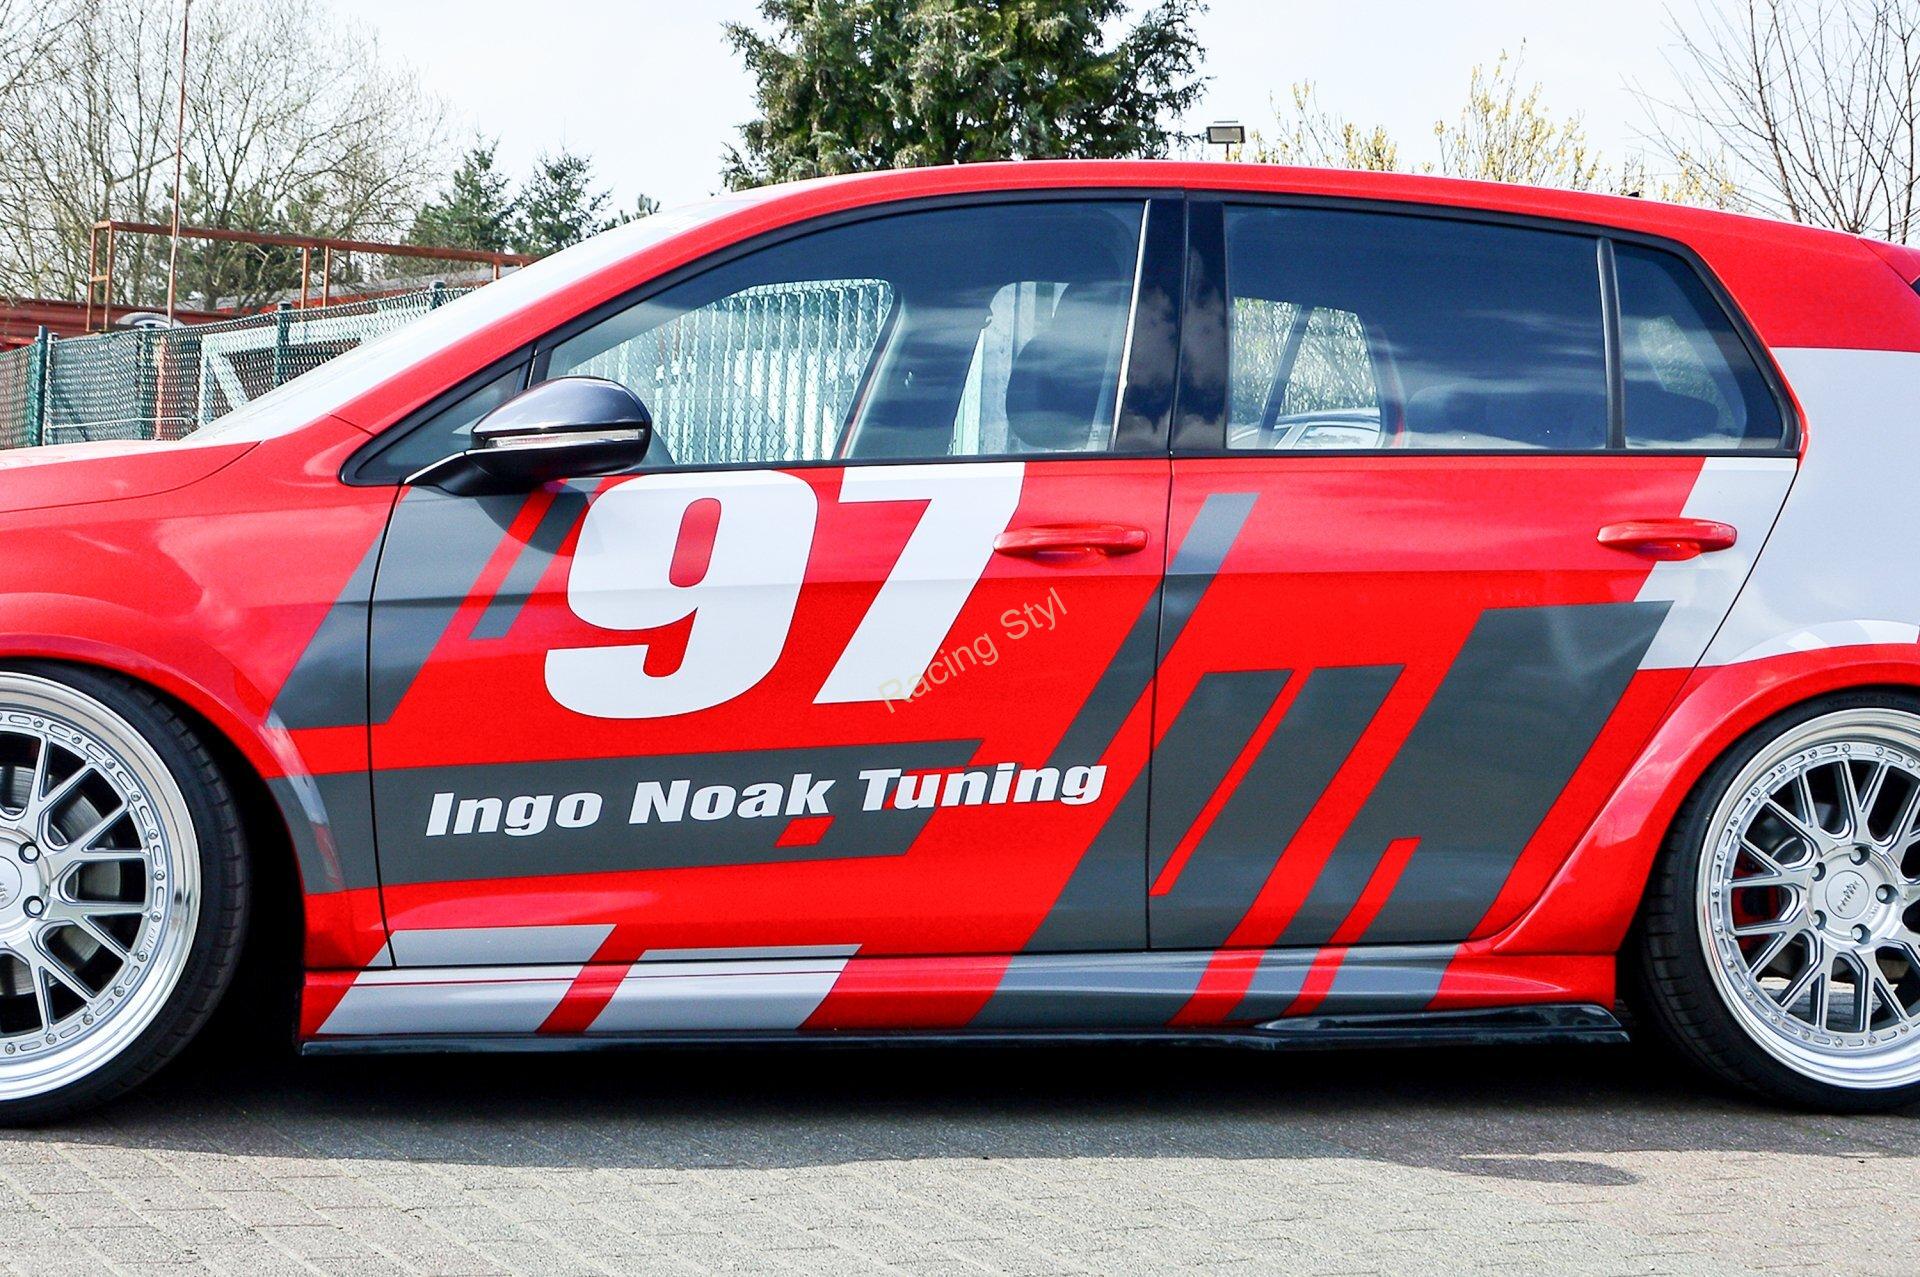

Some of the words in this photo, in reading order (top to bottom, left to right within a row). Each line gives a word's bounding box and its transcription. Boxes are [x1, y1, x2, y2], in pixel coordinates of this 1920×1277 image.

[544, 462, 1026, 720] 97
[425, 792, 603, 837] Ingo
[628, 773, 836, 825] Noak
[858, 762, 1108, 812] Tuning
